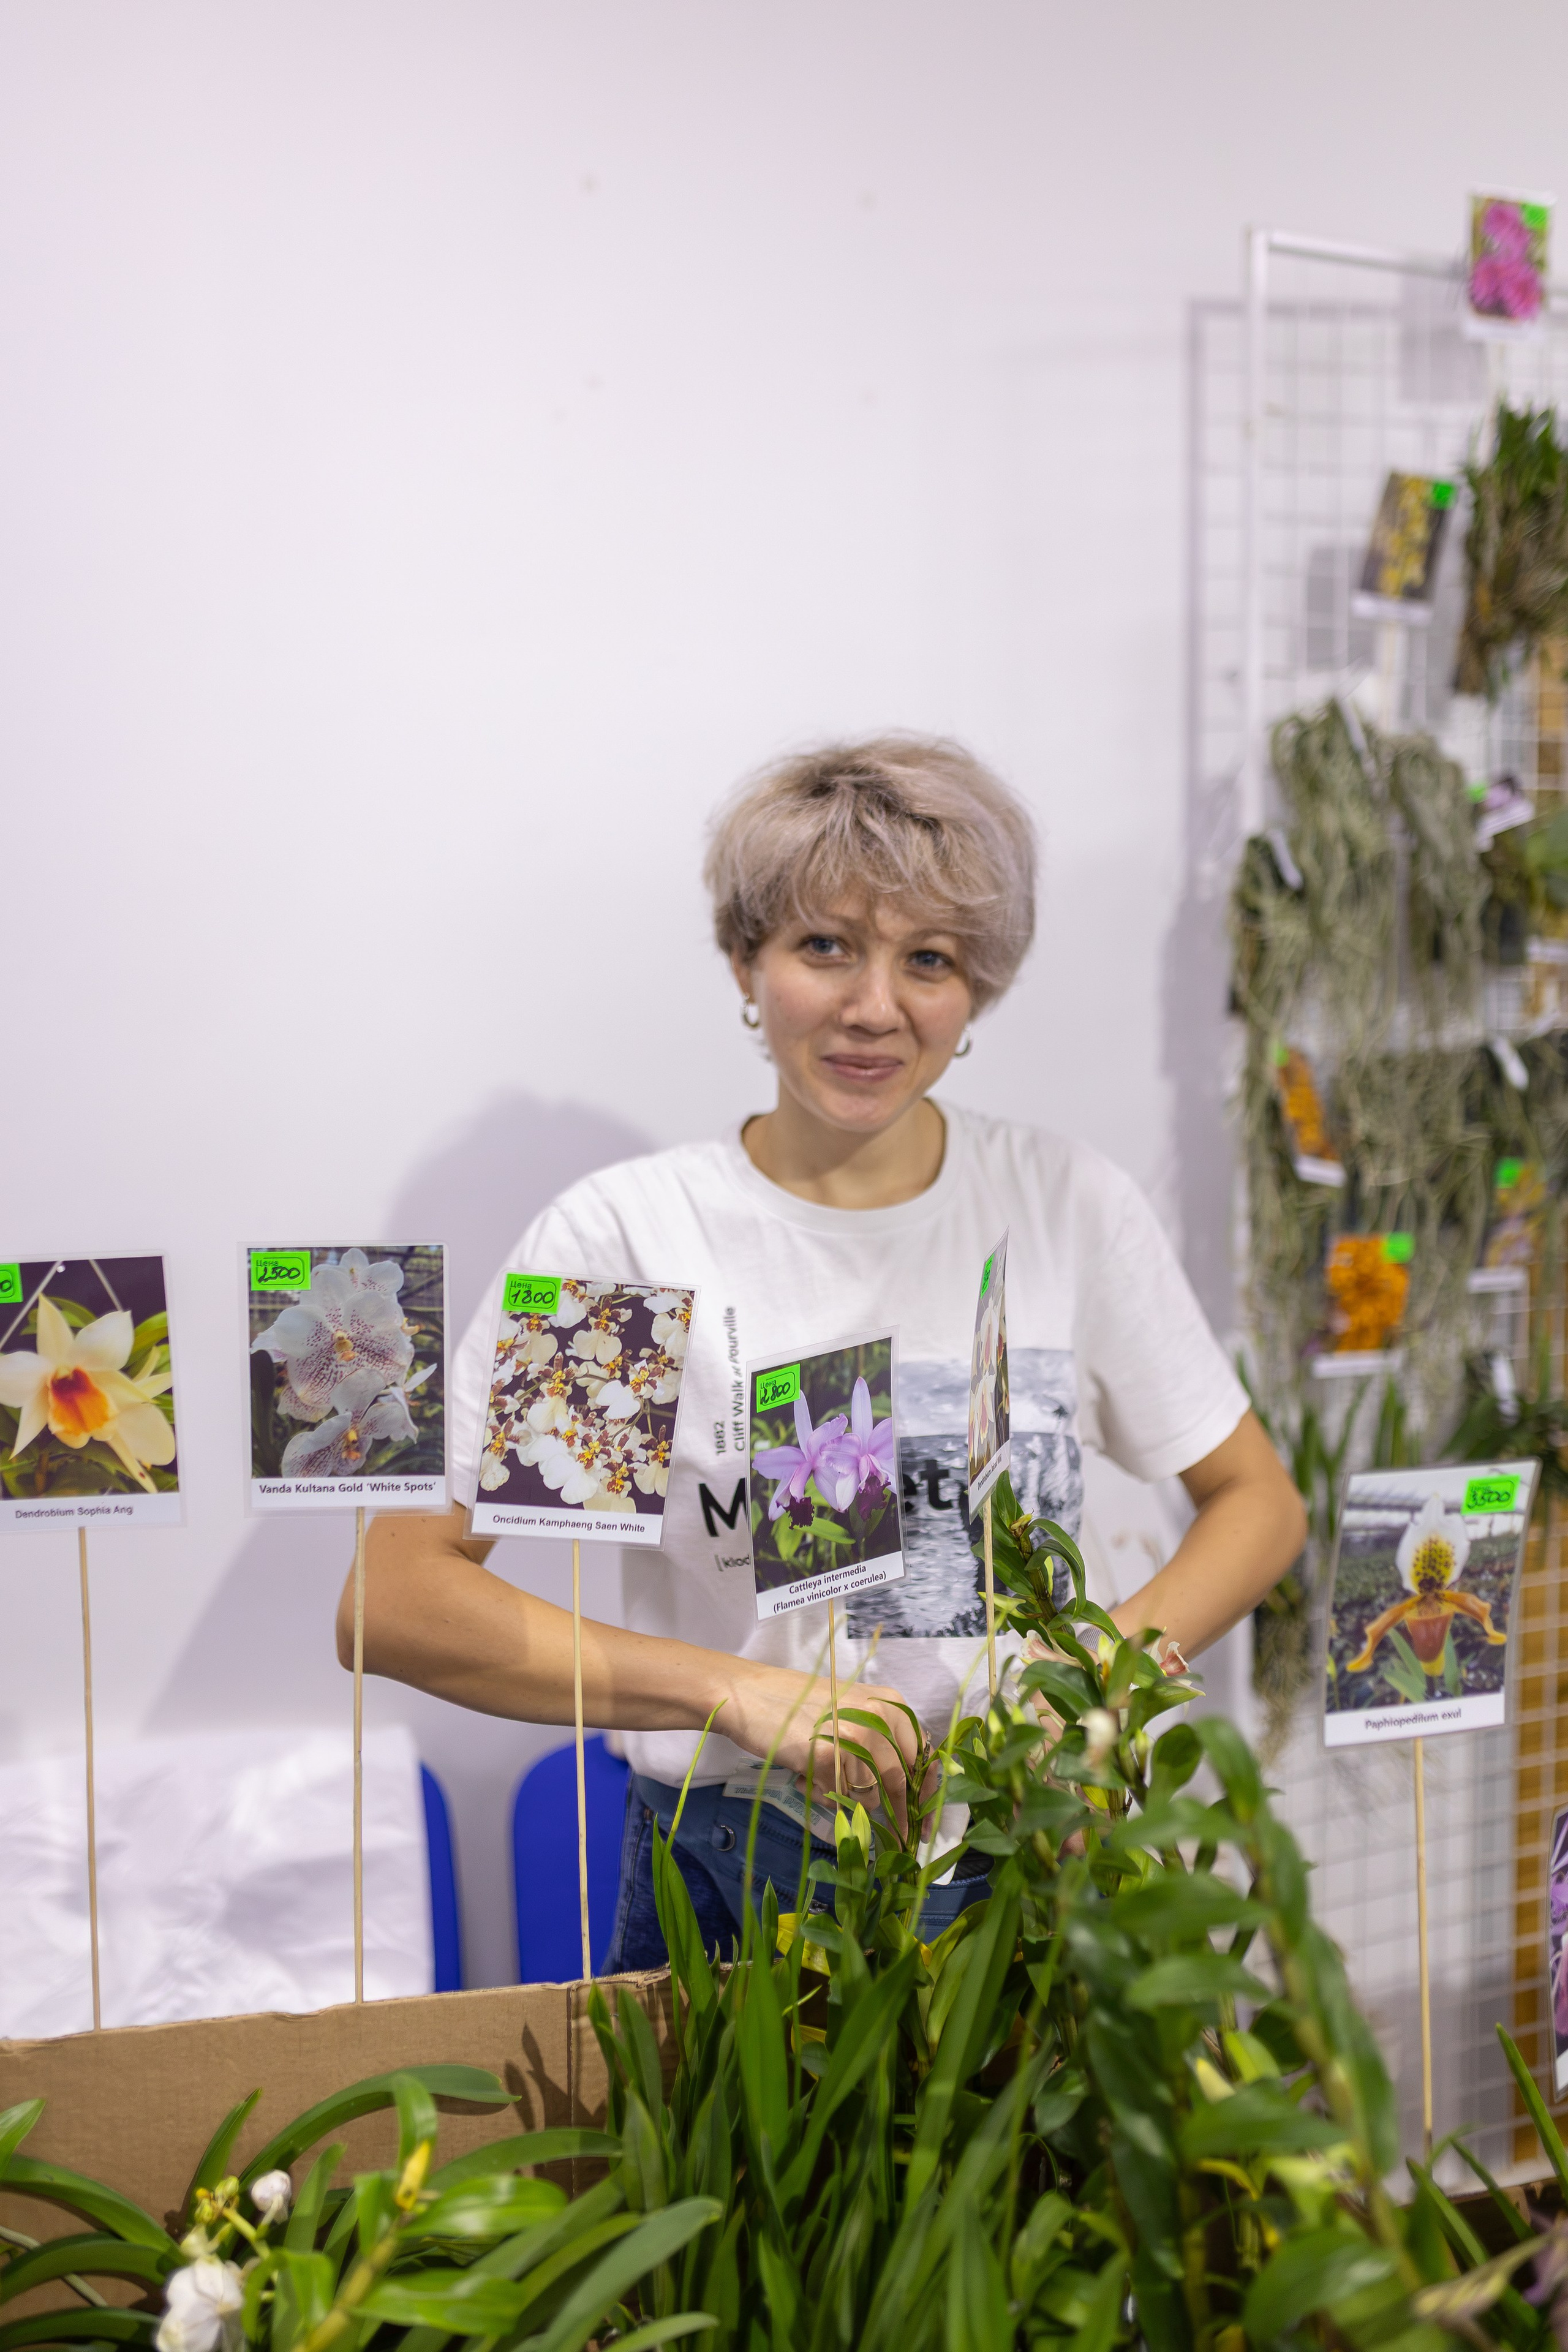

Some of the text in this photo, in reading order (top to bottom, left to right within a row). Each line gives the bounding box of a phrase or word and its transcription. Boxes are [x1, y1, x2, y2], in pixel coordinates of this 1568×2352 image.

[510, 1280, 532, 1289] Цена
[511, 1289, 554, 1303] 1800
[723, 1306, 740, 1364] Pourville
[760, 1380, 777, 1389] Цена
[760, 1382, 791, 1404] 2800
[731, 1380, 744, 1417] Walk
[714, 1420, 726, 1456] 1882
[733, 1421, 745, 1451] Cliff
[259, 1483, 292, 1494] Vanda
[295, 1483, 335, 1493] Kultana
[338, 1482, 363, 1493] Gold
[15, 1505, 134, 1519] Dendrobium Sophia Ang
[492, 1515, 646, 1532] Oncidium Kamphaeng Saen White
[789, 1564, 867, 1594] Cattleya intermedia
[774, 1597, 805, 1614] (Flamea
[807, 1585, 842, 1601] vinicolor
[851, 1570, 886, 1589] coerulea)
[1365, 1713, 1439, 1730] Paphiopedilum
